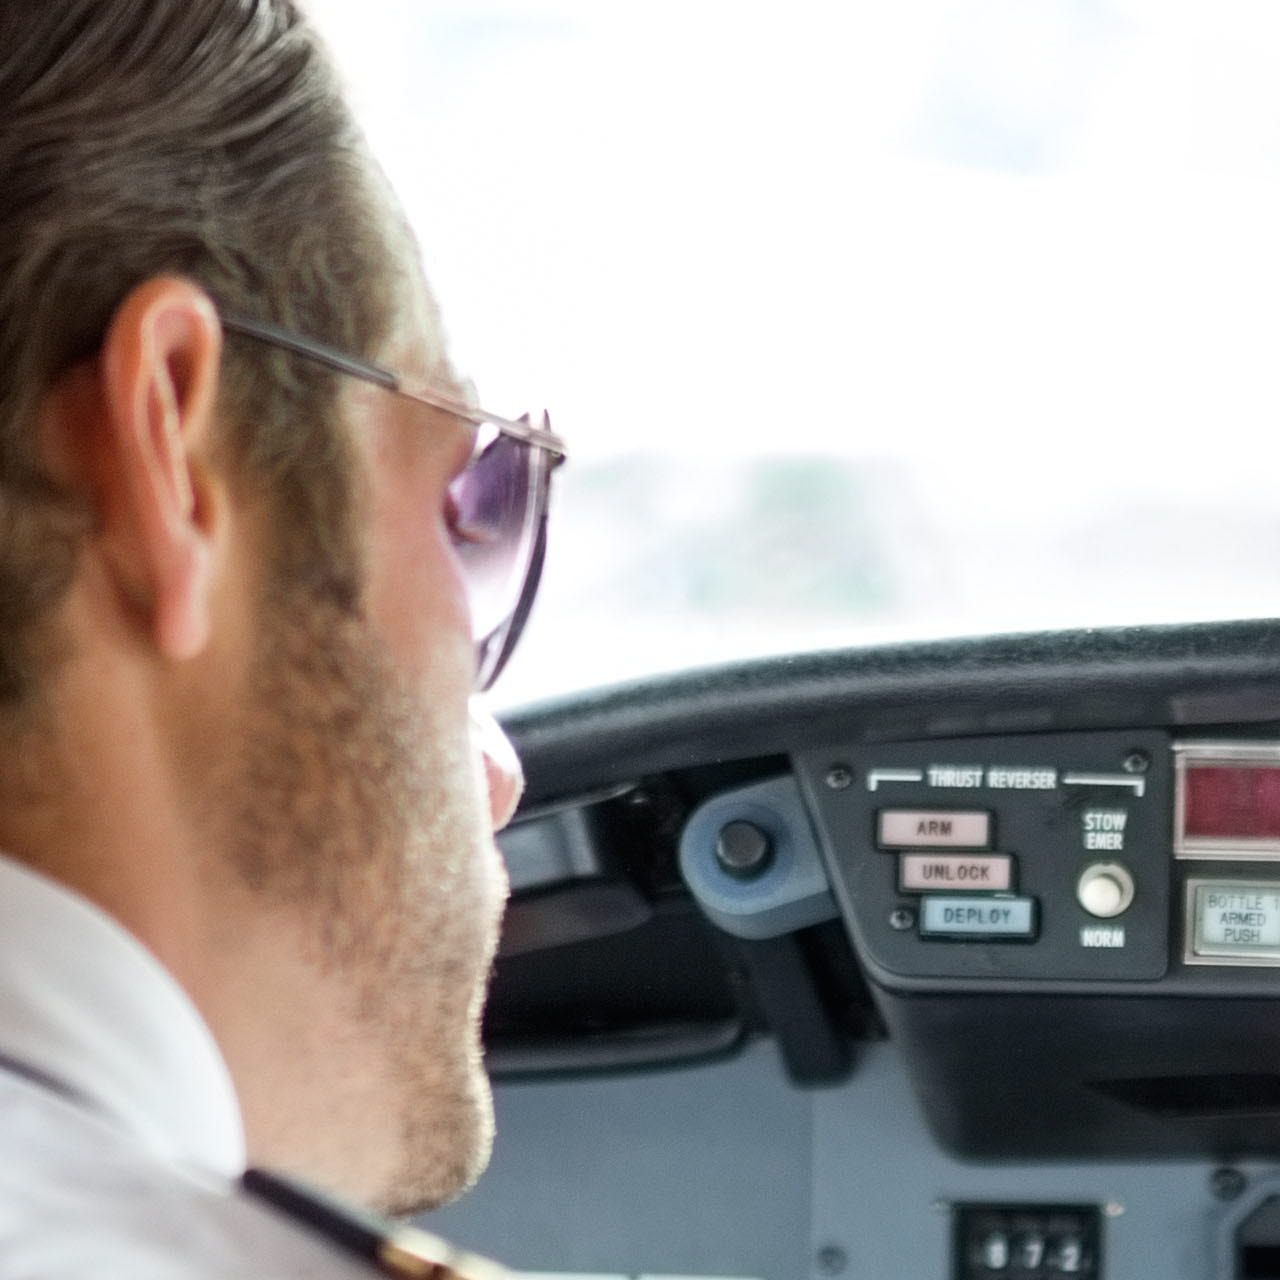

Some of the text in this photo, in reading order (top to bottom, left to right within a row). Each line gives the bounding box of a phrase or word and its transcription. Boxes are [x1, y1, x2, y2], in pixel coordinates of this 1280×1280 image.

[928, 767, 1057, 789] THRUST REVERSER
[916, 820, 953, 836] ARM
[1084, 811, 1127, 831] STOW
[1085, 832, 1123, 850] EMER
[922, 863, 991, 881] UNLOCK
[1208, 894, 1264, 910] BOTTLE
[943, 907, 1012, 925] DEPLOY
[1219, 912, 1266, 927] ARMED
[1081, 929, 1126, 947] NORM
[1223, 927, 1261, 943] PUSH
